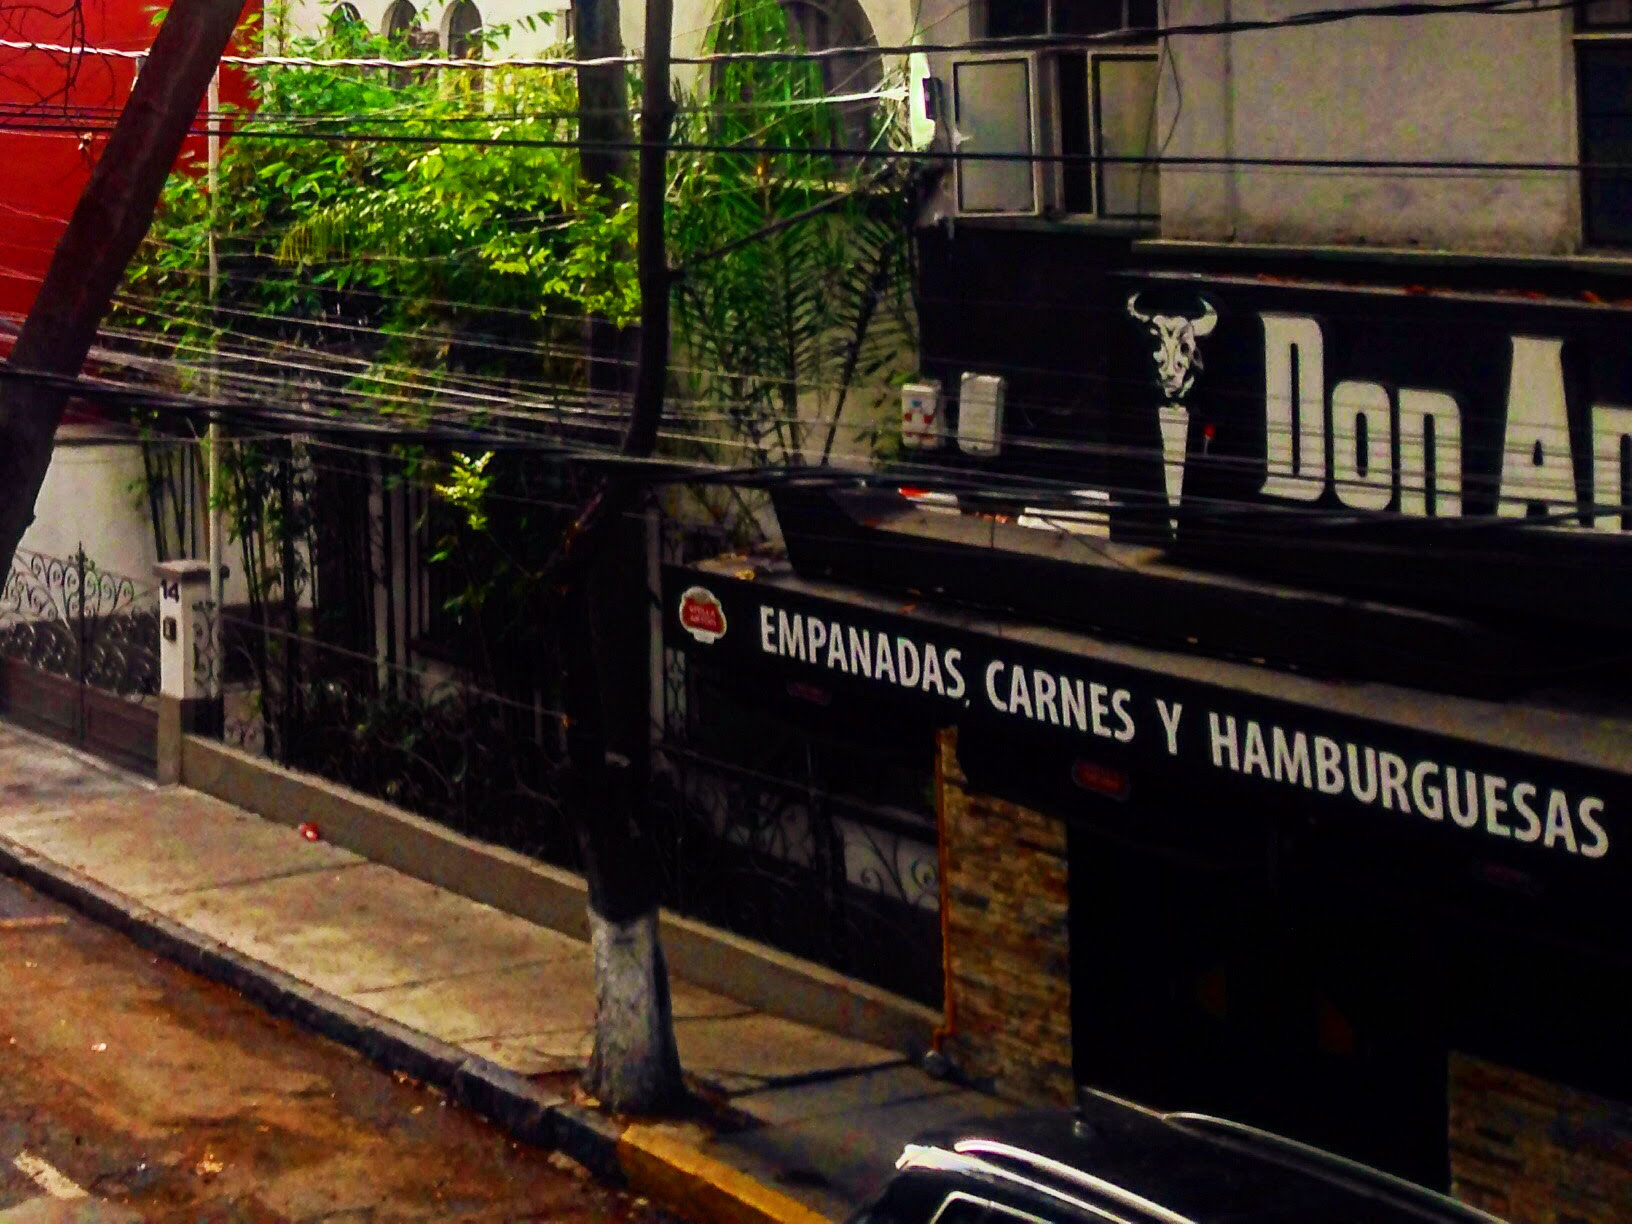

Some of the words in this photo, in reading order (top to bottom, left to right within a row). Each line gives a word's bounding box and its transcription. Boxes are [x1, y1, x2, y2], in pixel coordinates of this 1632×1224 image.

[1259, 311, 1462, 518] Don
[160, 578, 180, 604] 14
[759, 605, 970, 708] EMPANADAS,
[985, 660, 1136, 743] CARNES
[1155, 697, 1183, 756] Y
[1208, 710, 1610, 859] HAMBURGUESAS
